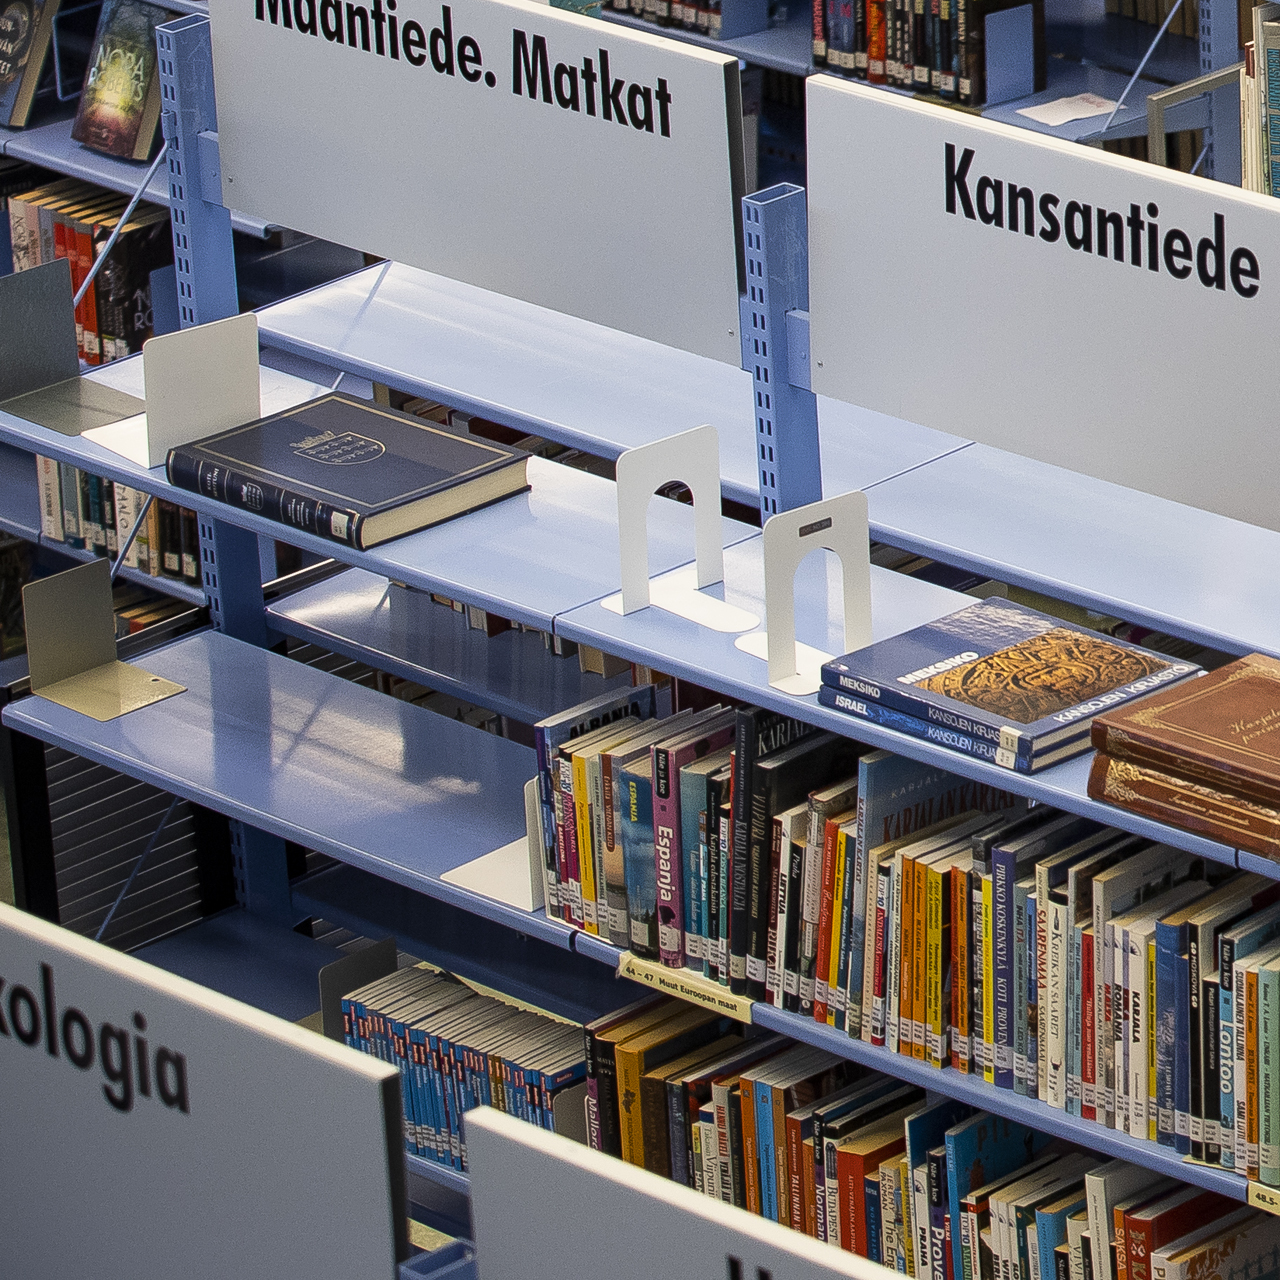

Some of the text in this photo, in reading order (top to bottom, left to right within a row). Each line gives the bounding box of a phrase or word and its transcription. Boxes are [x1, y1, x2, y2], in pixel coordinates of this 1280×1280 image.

[511, 28, 673, 138] Matkat
[944, 142, 1260, 299] Kansantiede
[839, 674, 881, 699] MEKSIKO
[897, 649, 980, 687] MEKSIKO
[835, 694, 869, 716] ISRAEL
[1052, 663, 1191, 724] KANSOJEN KIRJASTO
[927, 726, 971, 753] KANSOJEN
[928, 707, 972, 734] KANSOJEN
[655, 825, 673, 903] Espanja
[995, 863, 1007, 1006] PIRKKO KOSKENKYLÄ KOTI
[1036, 909, 1047, 990] SAARENMAA
[625, 966, 738, 1013] 44 47 Muut Euroopan maat
[1190, 955, 1199, 996] MOSKOVA
[1113, 982, 1124, 1043] ROMANIA
[1131, 990, 1142, 1044] KARJALA
[1219, 1021, 1234, 1094] Lontoo
[826, 1185, 839, 1240] BUDAPEST
[879, 1171, 888, 1211] PAXMAN
[886, 1173, 894, 1214] JEREMY
[1254, 1191, 1279, 1208] 48.5-
[919, 1226, 928, 1268] PRAHA
